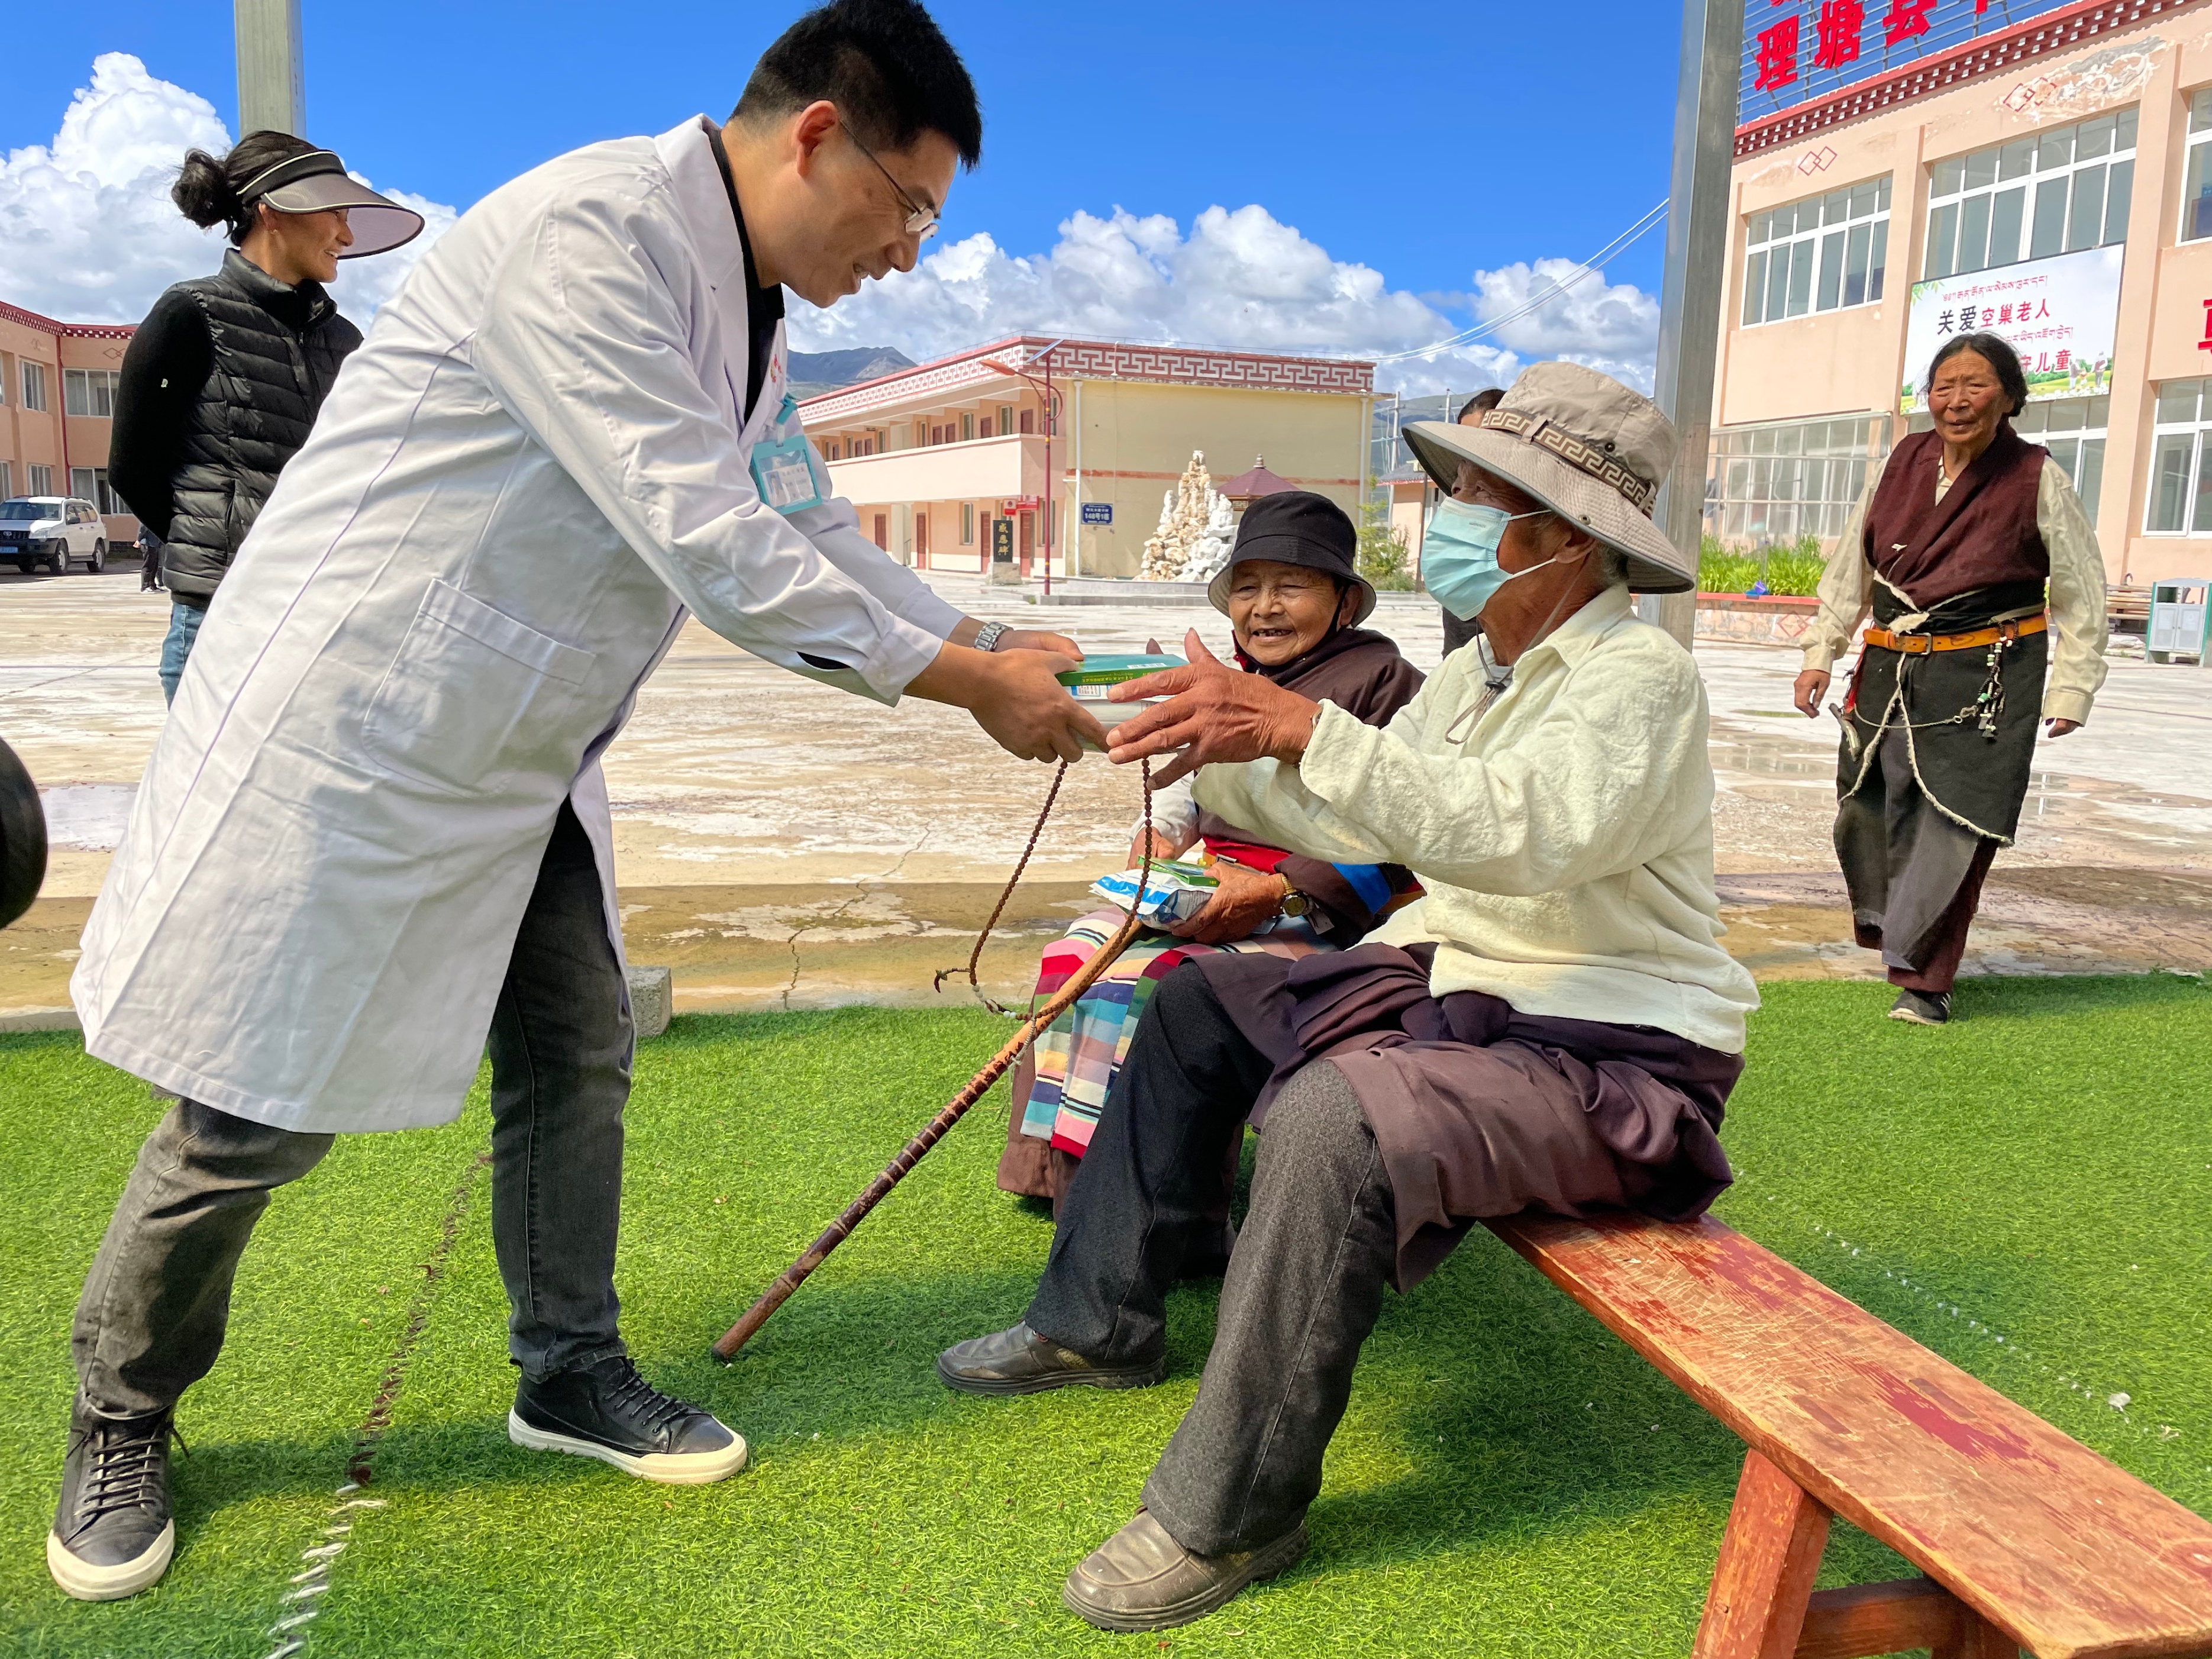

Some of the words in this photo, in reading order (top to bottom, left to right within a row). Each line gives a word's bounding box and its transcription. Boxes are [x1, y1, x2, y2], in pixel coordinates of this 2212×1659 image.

[1754, 0, 1988, 92] 理塘县
[1936, 299, 2050, 335] 关爱空巢老人
